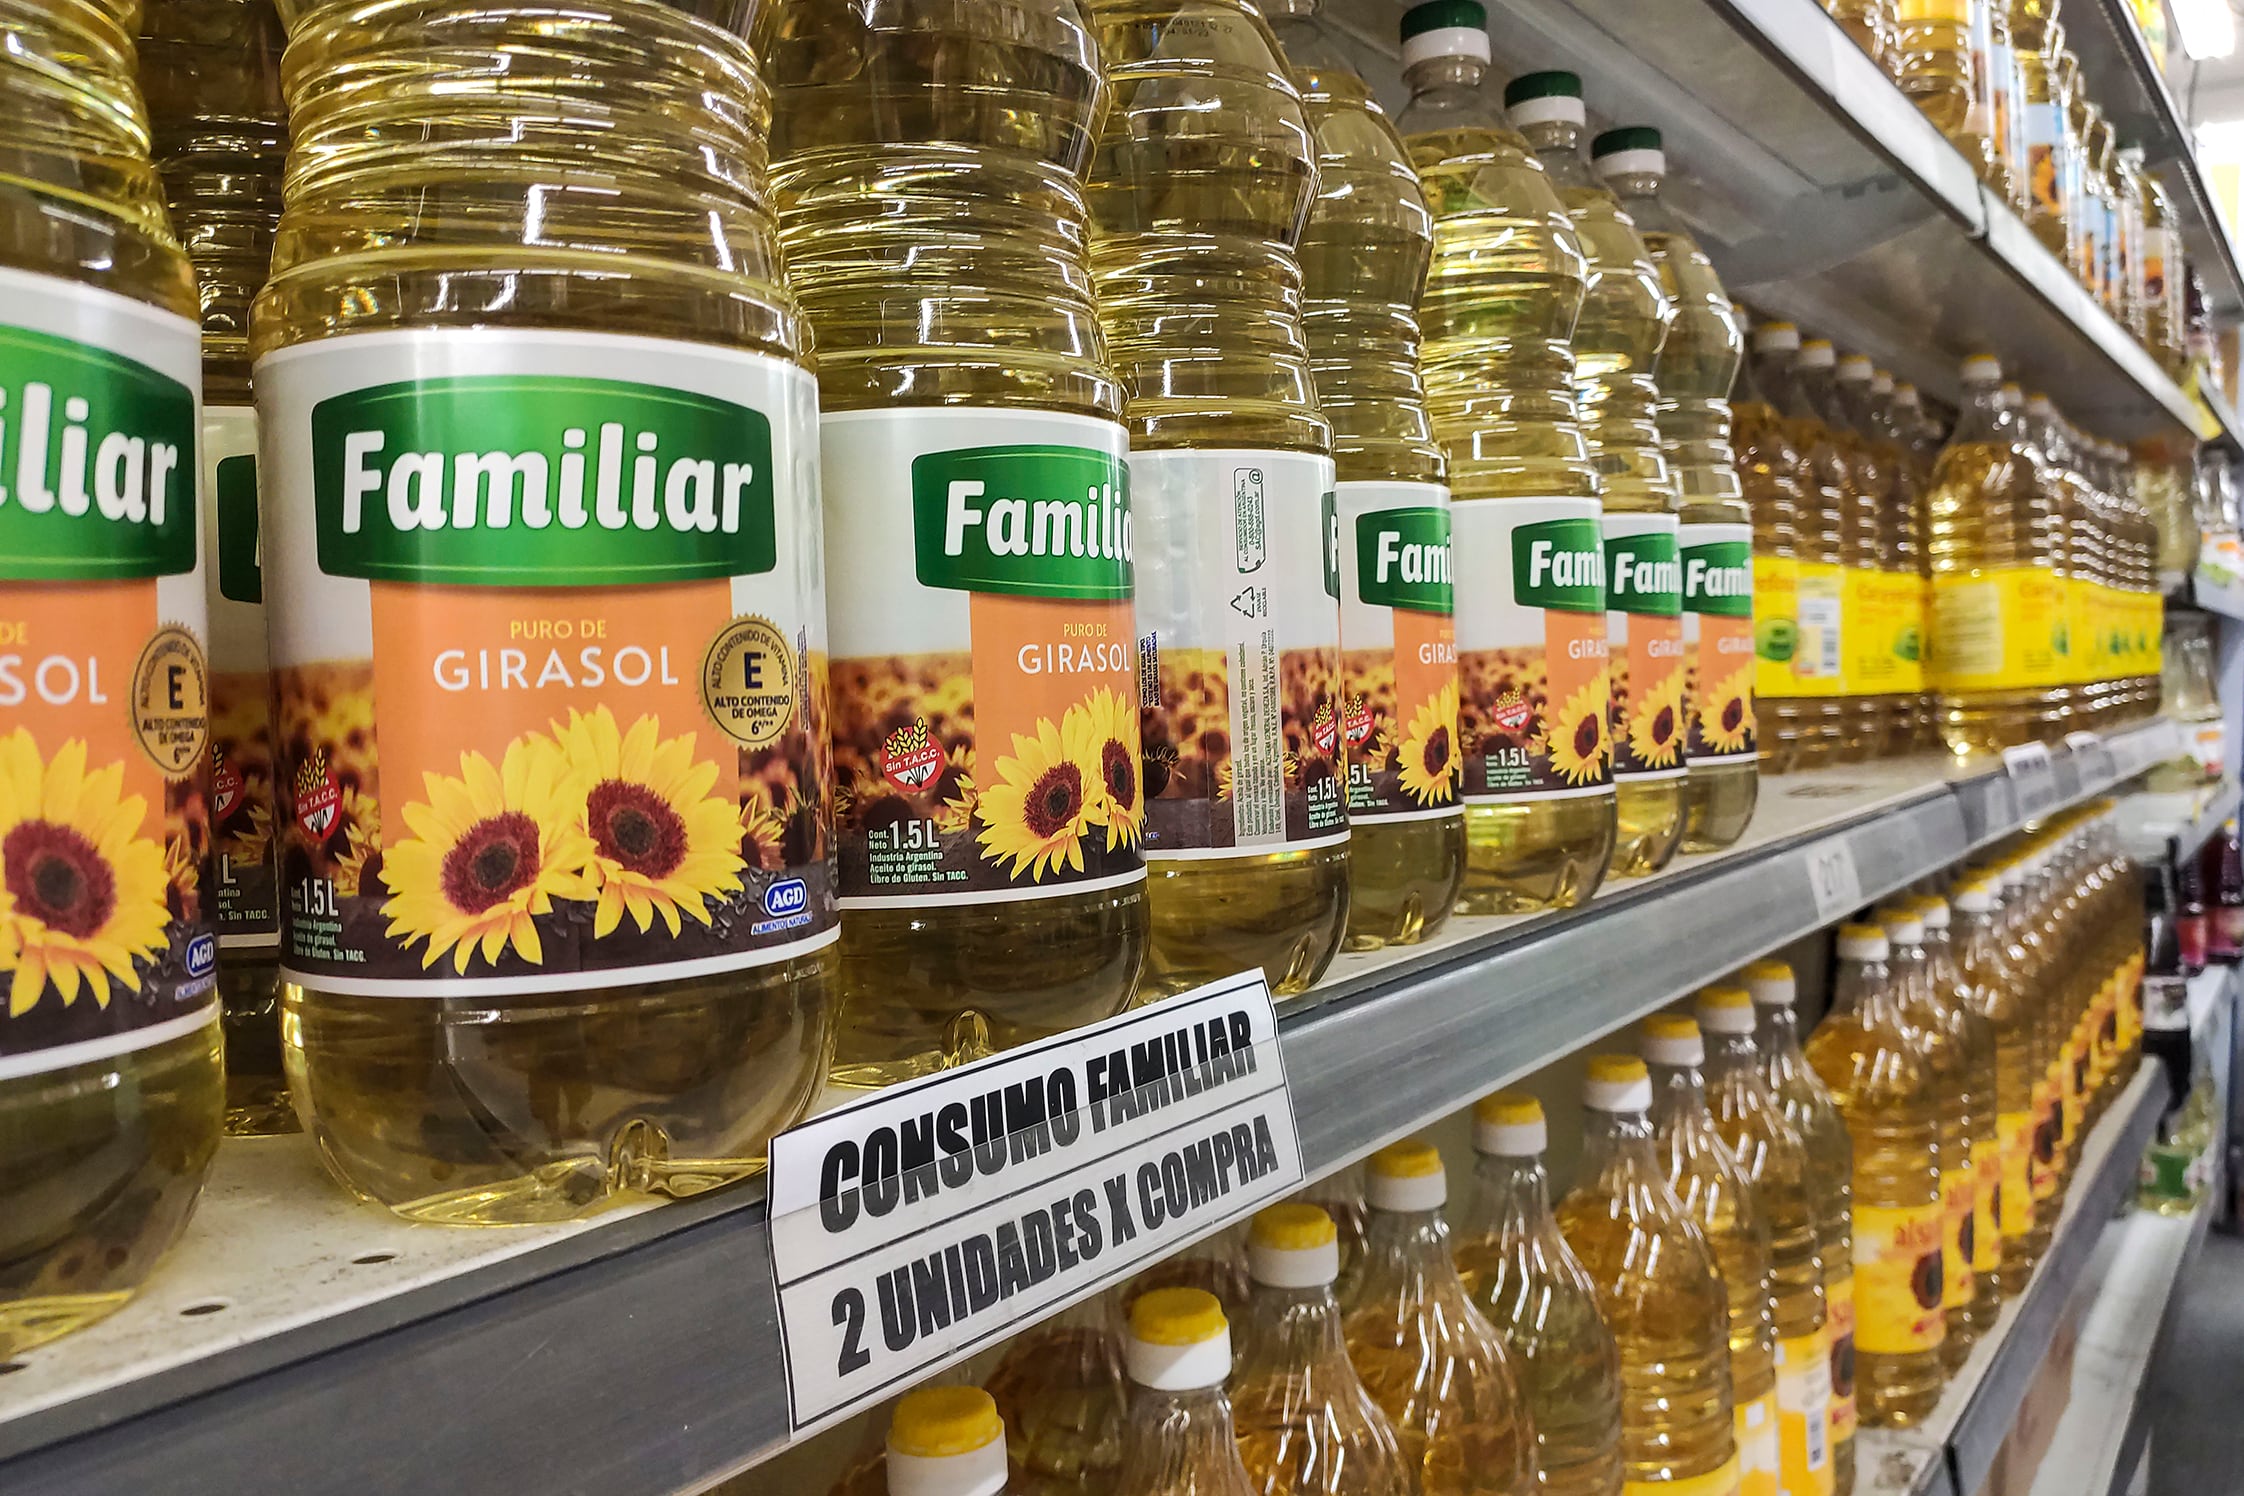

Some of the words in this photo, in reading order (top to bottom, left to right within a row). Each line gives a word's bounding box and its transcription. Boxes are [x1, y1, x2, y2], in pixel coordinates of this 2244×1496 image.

[0, 382, 178, 526] liar
[343, 423, 752, 534] Familiar
[944, 480, 1132, 563] Familia
[510, 620, 572, 639] PURO
[580, 620, 607, 639] DE
[1063, 624, 1094, 637] PURO
[1096, 624, 1108, 637] DE
[760, 633, 771, 647] DE
[1017, 643, 1130, 674] GIRASOL
[434, 646, 678, 691] GIRASOL
[714, 696, 739, 708] ALTO
[741, 695, 790, 707] CONTENIDO
[732, 708, 745, 719] DE
[746, 707, 778, 719] OMEGA
[885, 762, 902, 773] Sin
[903, 749, 940, 766] T.A.C.C.
[868, 830, 889, 839] Cont.
[868, 839, 887, 850] Neto
[869, 853, 904, 863] Industria
[905, 851, 943, 864] Argentina
[869, 863, 894, 873] Aceite
[895, 863, 905, 872] de
[907, 861, 937, 875] girasol.
[870, 874, 889, 884] Libre
[891, 874, 901, 883] de
[903, 872, 930, 882] Gluten.
[932, 872, 945, 881] Sin
[771, 886, 804, 909] AGD
[819, 1067, 1081, 1234] CONSUMO
[1085, 1010, 1257, 1133] FAMILIAR
[831, 1287, 871, 1378] 2
[876, 1188, 1104, 1353] UNIDADES
[1103, 1172, 1137, 1249] X
[1137, 1113, 1279, 1230] COMPRA
